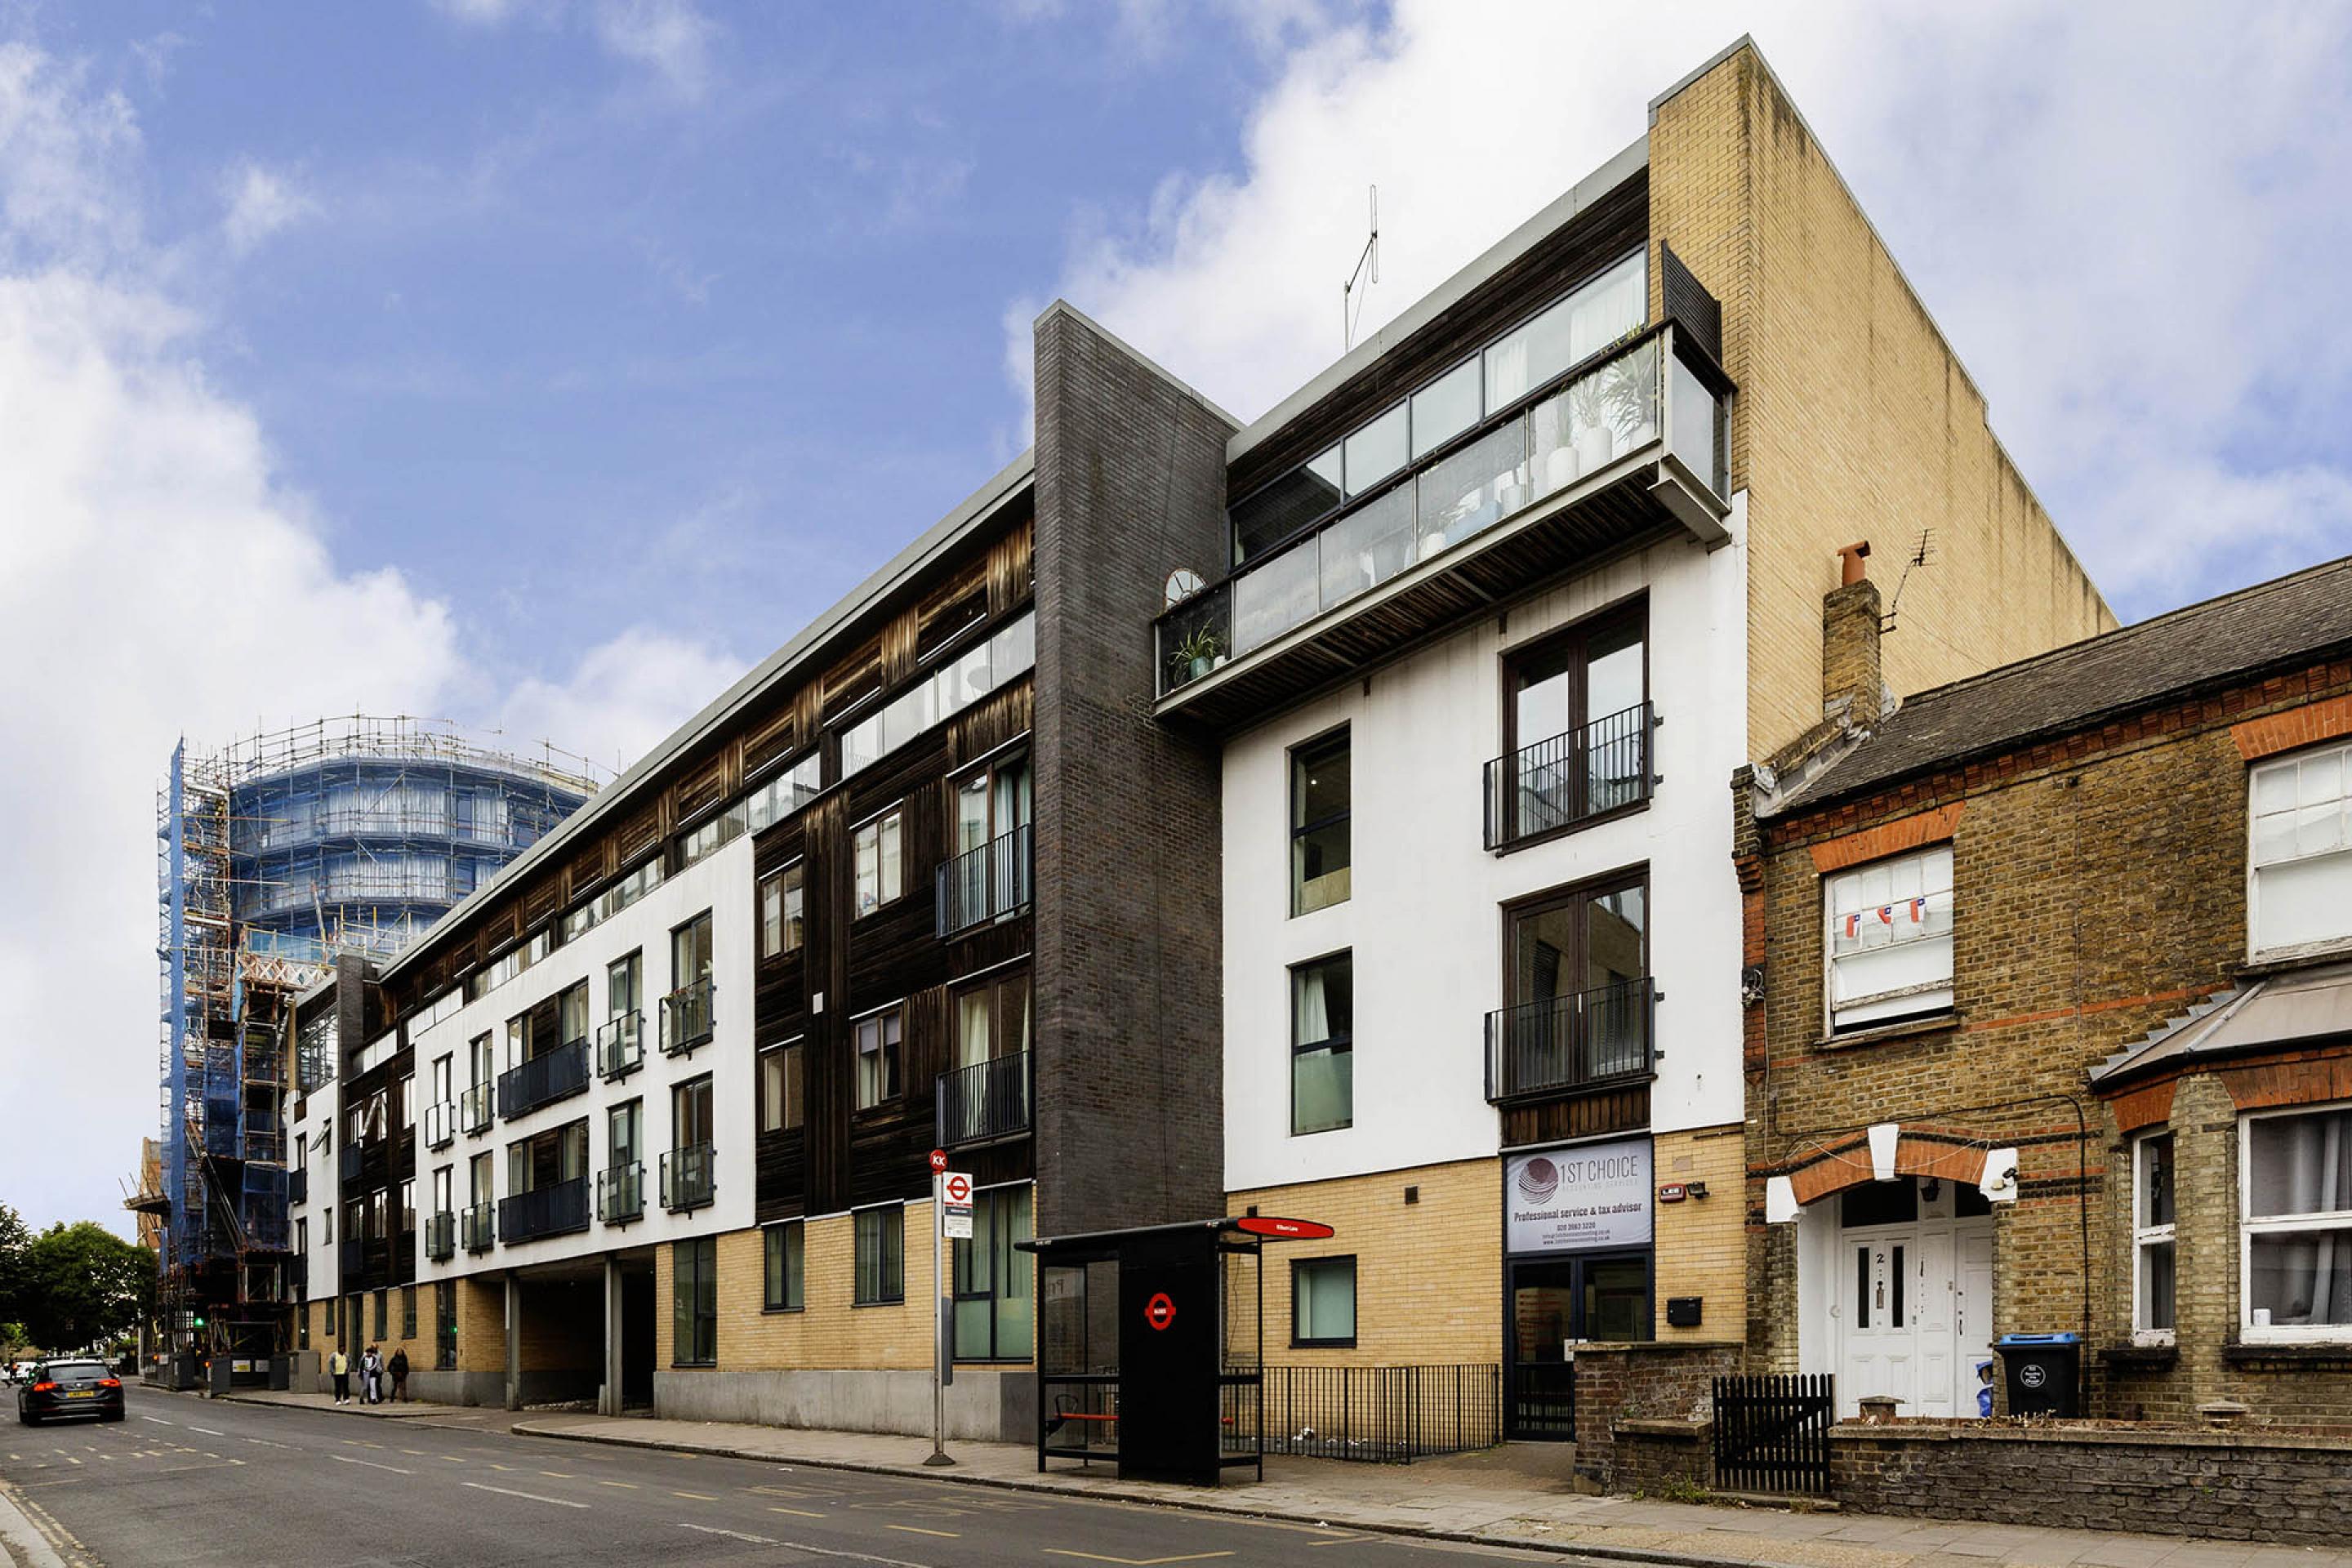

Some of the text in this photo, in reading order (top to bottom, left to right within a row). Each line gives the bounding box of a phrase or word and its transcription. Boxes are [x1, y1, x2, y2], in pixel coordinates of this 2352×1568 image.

[933, 1155, 945, 1166] KK
[1560, 1156, 1637, 1184] 1ST CHOICE
[1514, 1202, 1642, 1222] Professional service & tax advisor
[1876, 1254, 1884, 1264] 2
